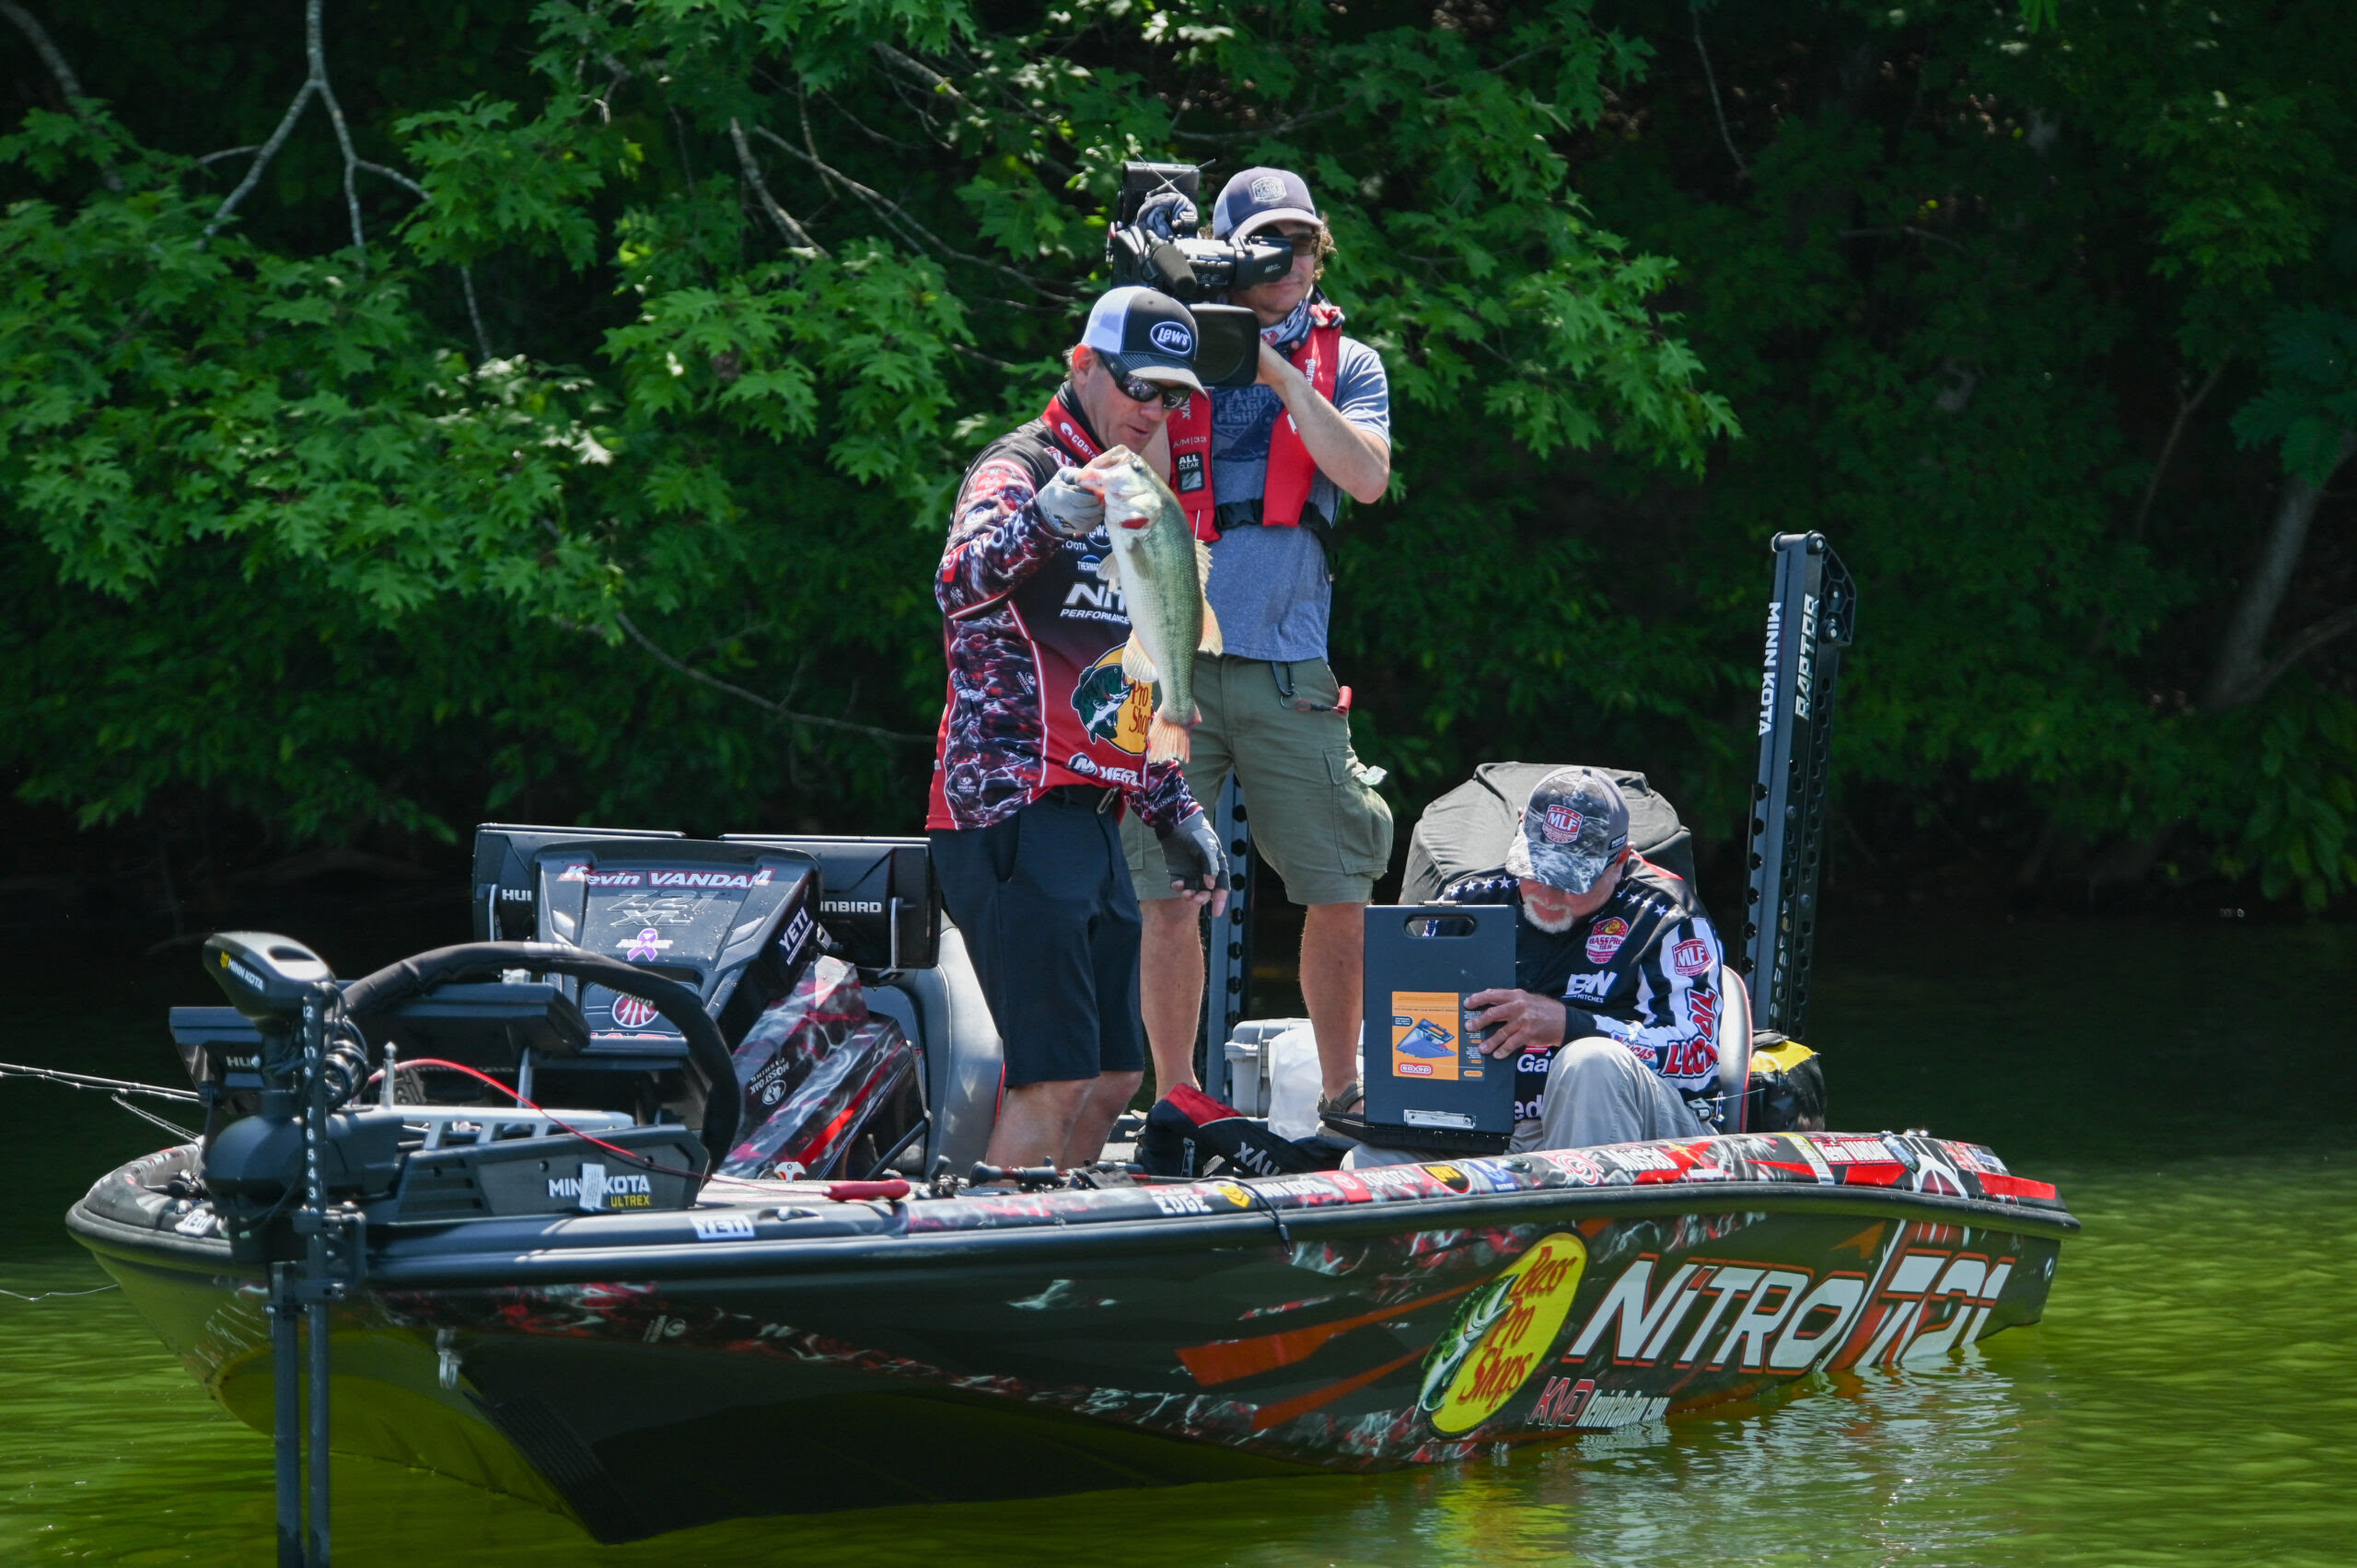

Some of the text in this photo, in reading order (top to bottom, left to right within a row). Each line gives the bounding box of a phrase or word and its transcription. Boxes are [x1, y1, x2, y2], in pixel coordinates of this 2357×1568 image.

[1178, 454, 1200, 464] ALL
[1178, 462, 1200, 470] CLEAR
[1060, 609, 1131, 625] PERFORMANCE
[1795, 593, 1820, 722] RAPTOR
[1758, 601, 1782, 737] MINN KOTA
[1131, 679, 1149, 708] Pro
[1548, 812, 1578, 831] MLF
[778, 906, 809, 952] YETI
[1677, 946, 1706, 968] MLF
[307, 1128, 314, 1140] 6
[307, 1148, 315, 1161] 5
[308, 1167, 316, 1179] 4
[308, 1186, 316, 1199] 3
[549, 1178, 582, 1198] MIN
[602, 1174, 652, 1194] KOTA
[610, 1194, 652, 1208] ULTREX
[1153, 1195, 1213, 1214] EDGE
[1508, 1246, 1578, 1299] Bass
[1483, 1296, 1537, 1348] Pro
[1563, 1254, 1866, 1372] NITRO
[1457, 1348, 1535, 1413] Shops
